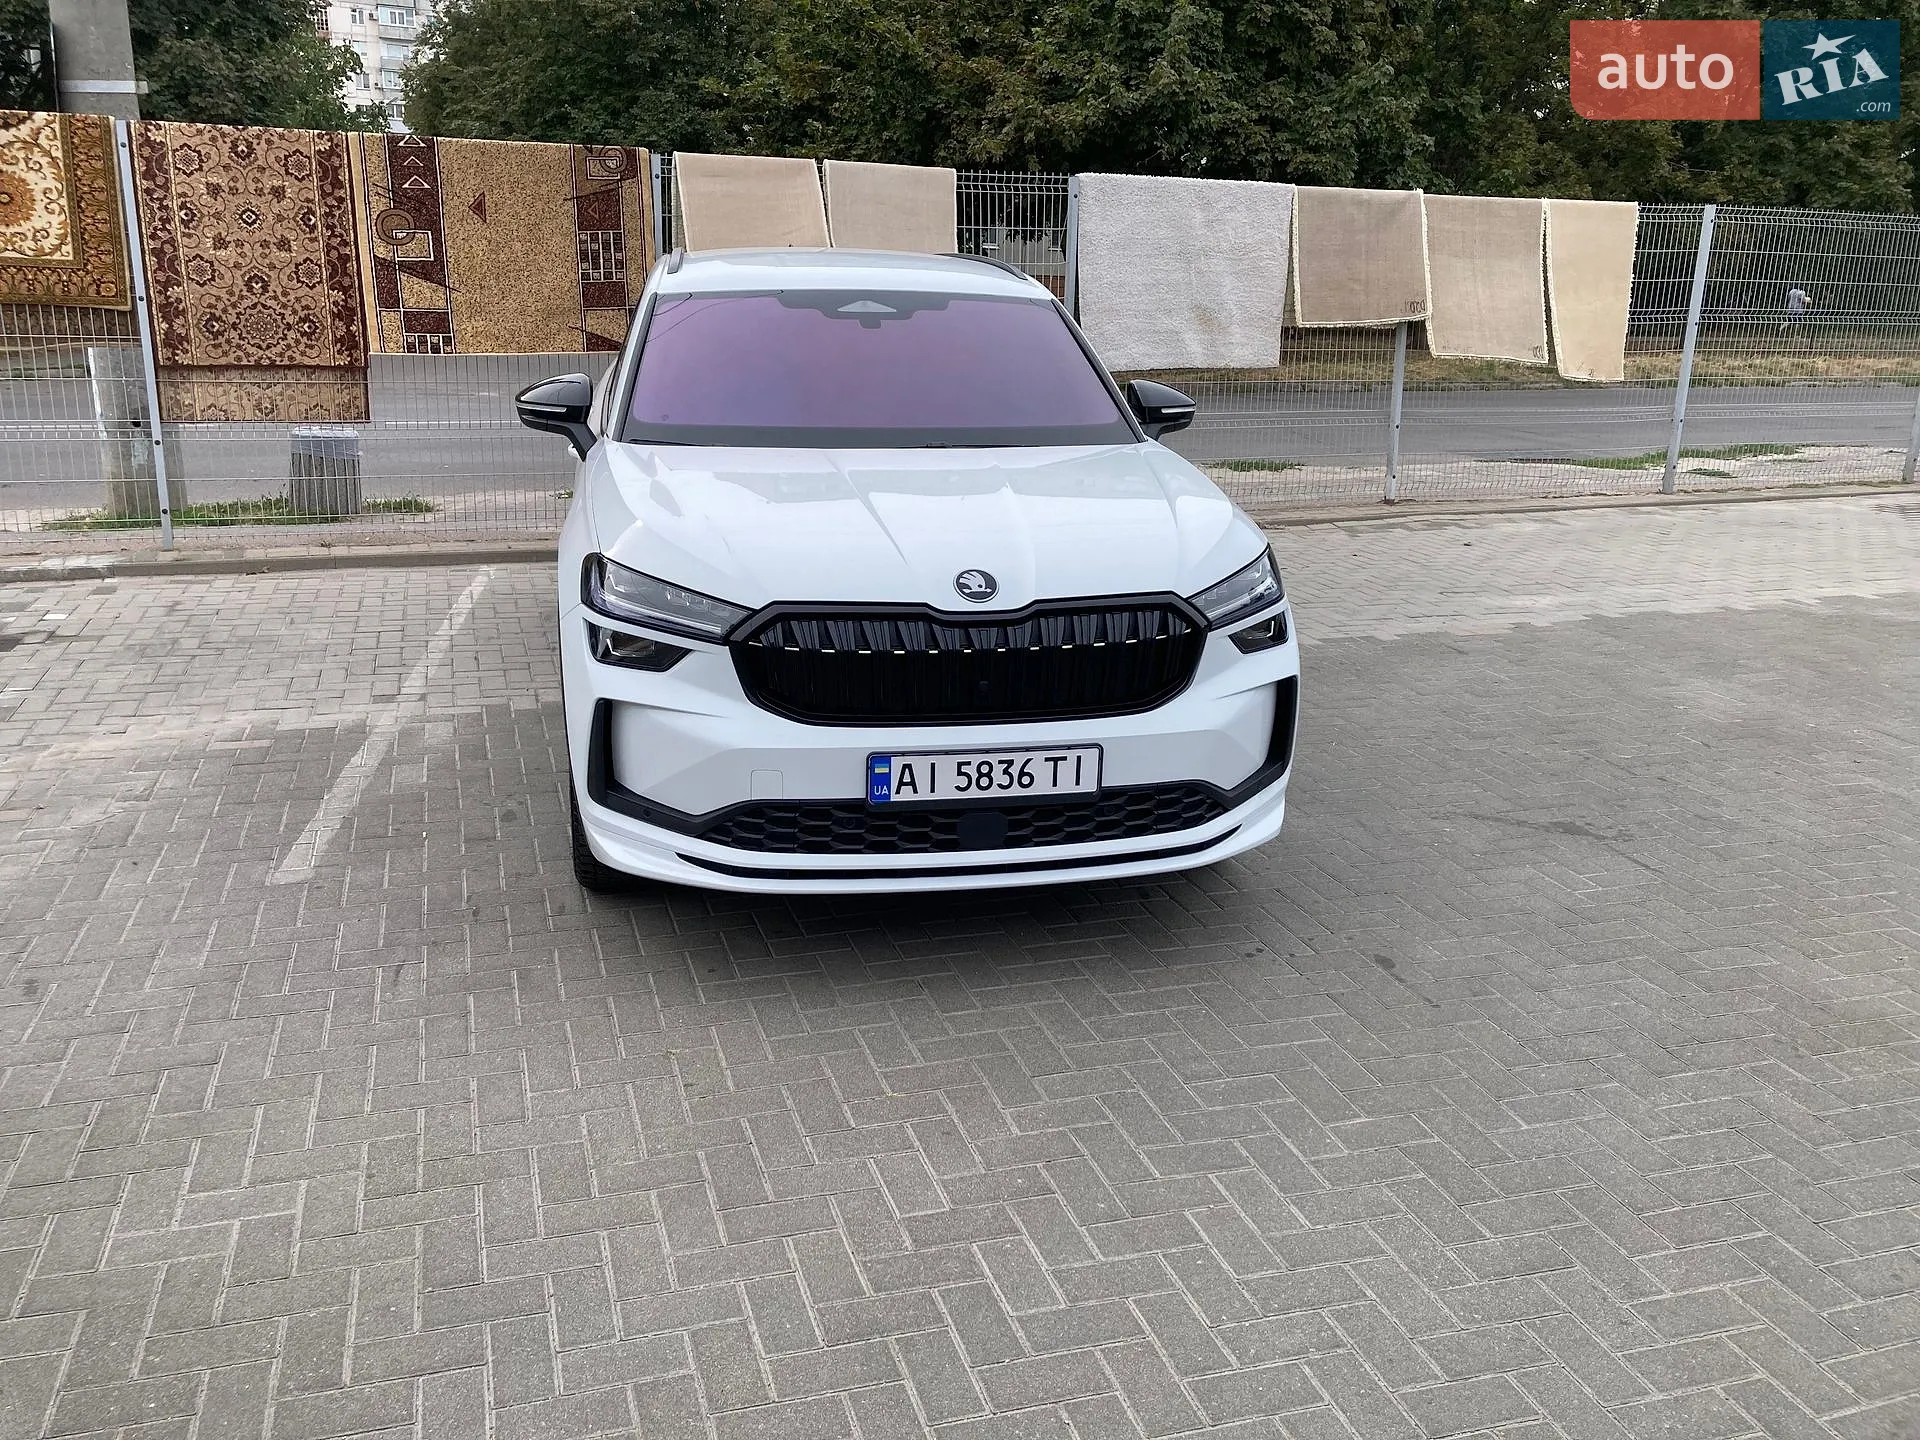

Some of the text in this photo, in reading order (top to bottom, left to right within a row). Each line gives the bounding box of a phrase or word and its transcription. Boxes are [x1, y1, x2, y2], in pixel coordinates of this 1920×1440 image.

[895, 755, 1082, 794] AI 5836 TI
[874, 785, 889, 795] UA
